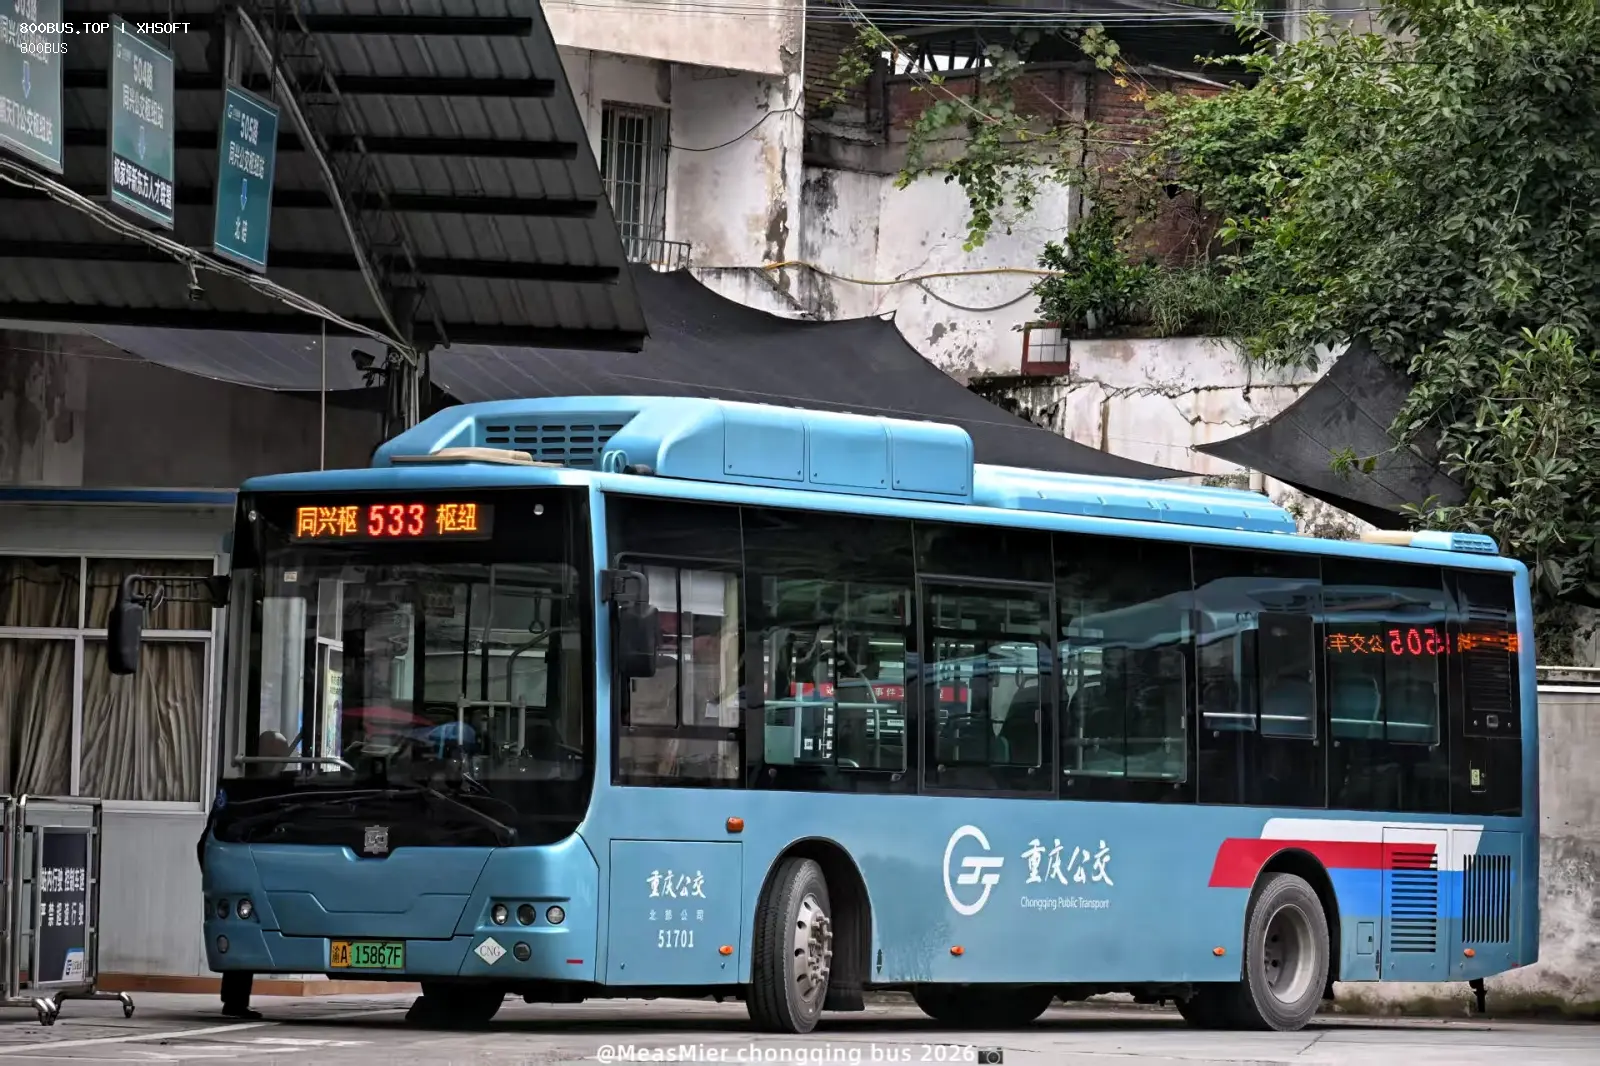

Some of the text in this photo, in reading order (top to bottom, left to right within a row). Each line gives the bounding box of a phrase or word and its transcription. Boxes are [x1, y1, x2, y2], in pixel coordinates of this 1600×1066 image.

[240, 112, 259, 146] 505路
[296, 503, 478, 537] 同兴枢 533 枢纽
[1020, 838, 1114, 886] 重庆公交
[646, 869, 707, 899] 重庆公交
[1020, 896, 1110, 911] Chongqing Public Transport
[479, 944, 501, 957] CNG
[657, 929, 694, 948] 51701
